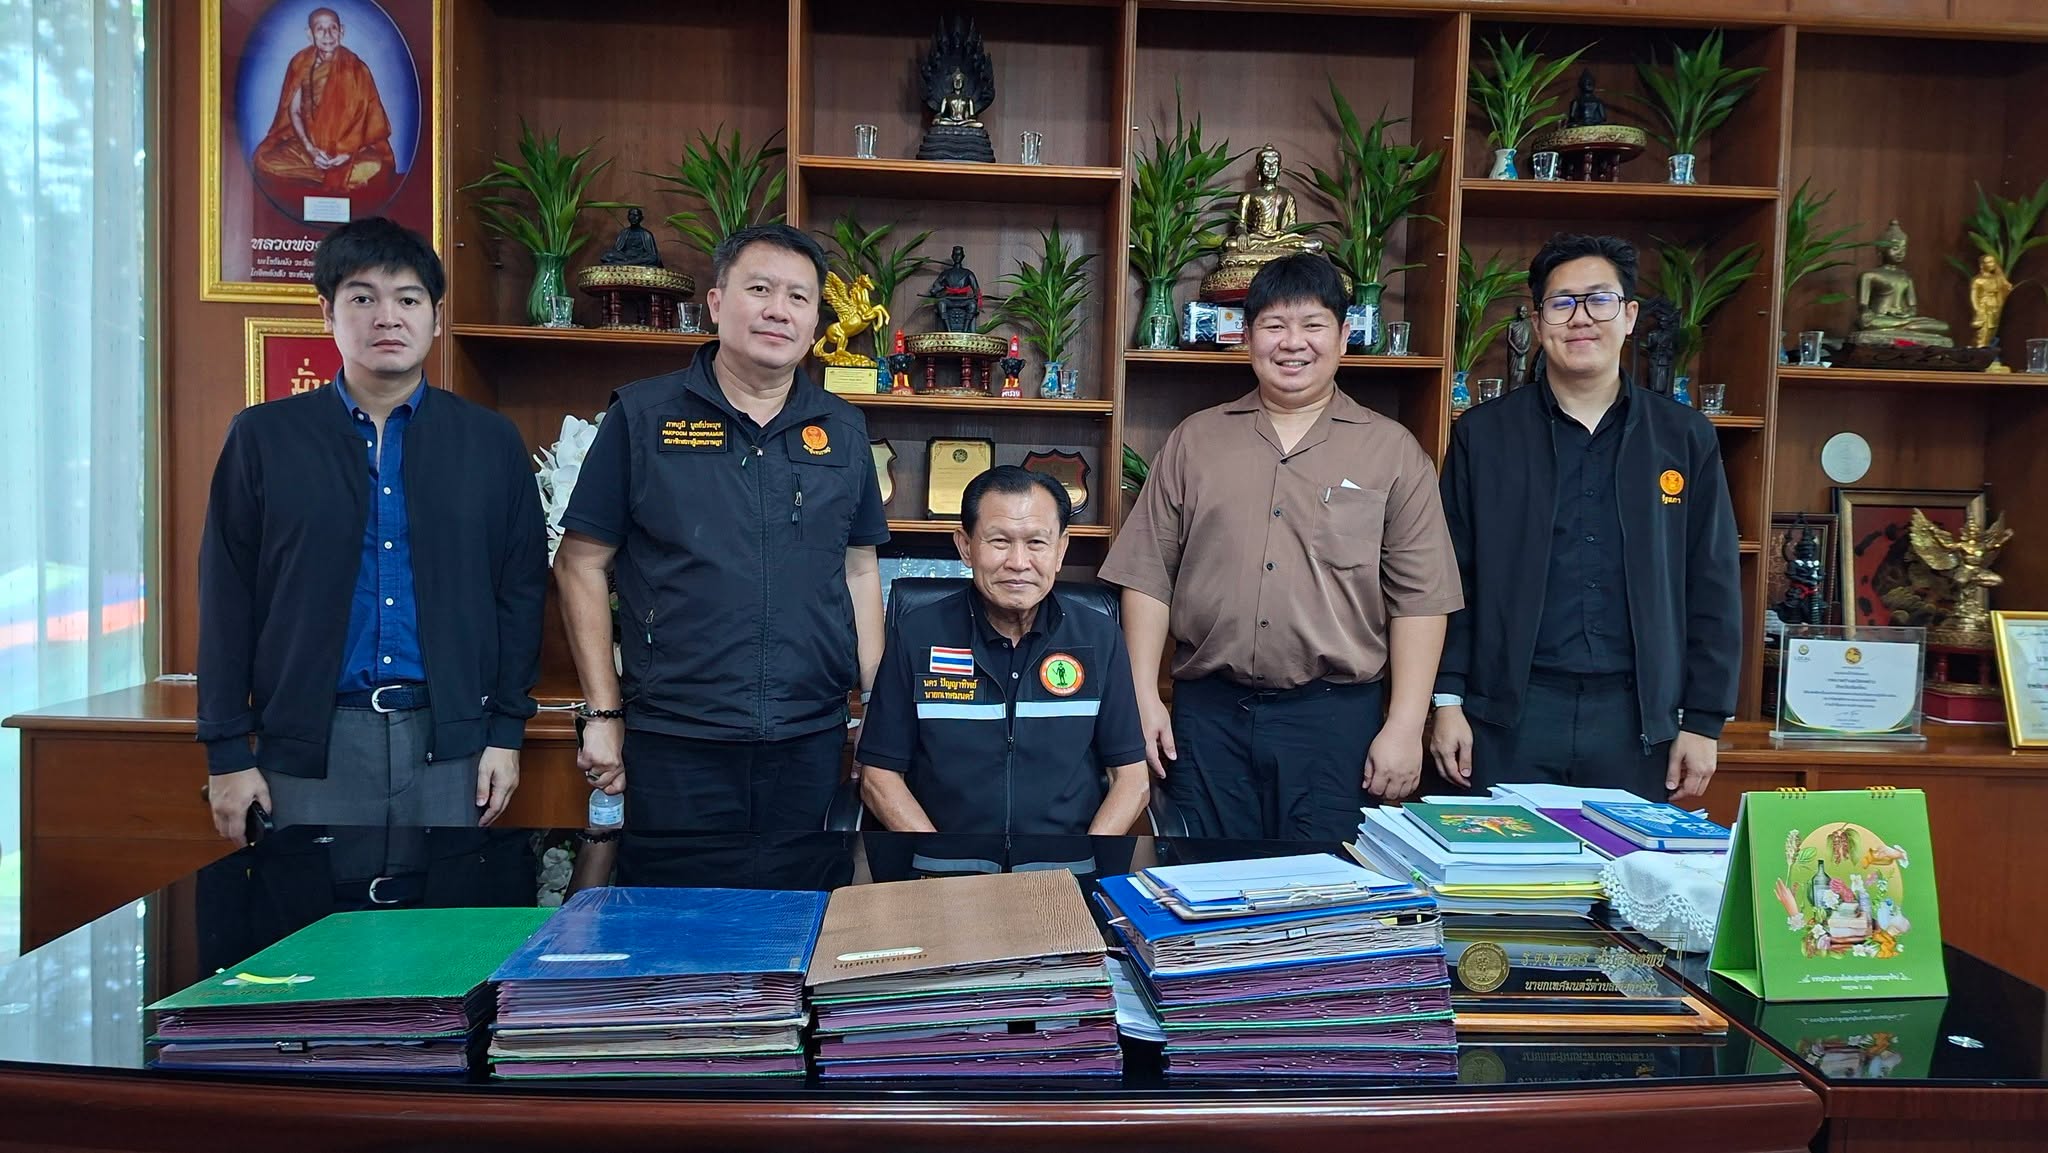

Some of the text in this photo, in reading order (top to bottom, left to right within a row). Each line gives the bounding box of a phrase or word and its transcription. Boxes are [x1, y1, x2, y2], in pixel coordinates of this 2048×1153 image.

[923, 677, 978, 690] นคร ปัญญาทิพย์
[924, 690, 975, 701] นายกเทศมนตรี
